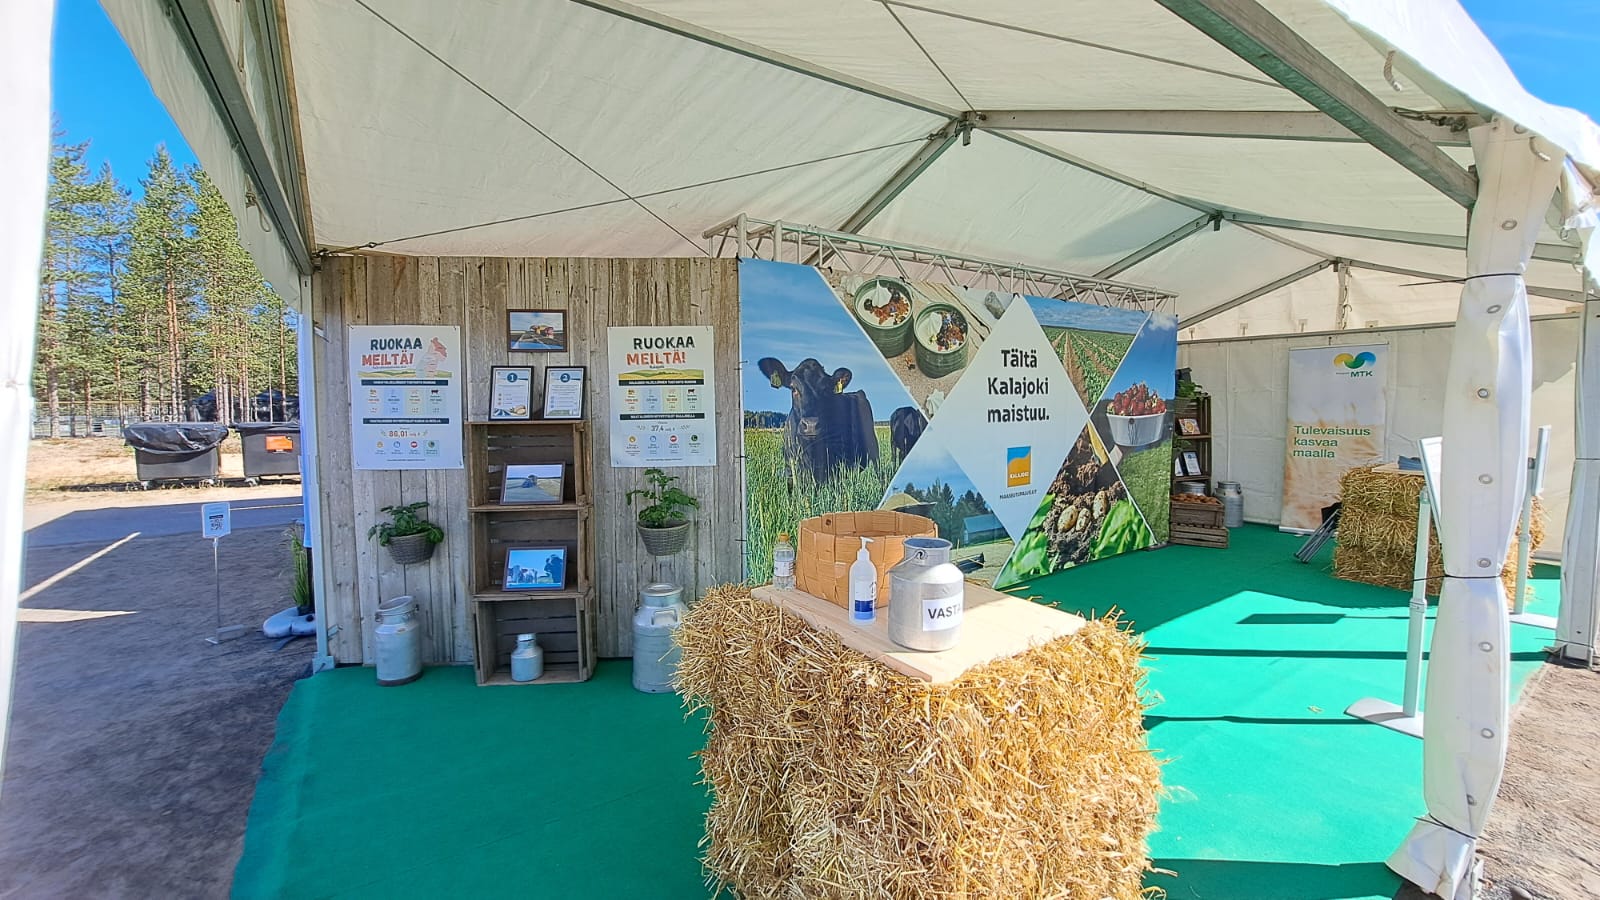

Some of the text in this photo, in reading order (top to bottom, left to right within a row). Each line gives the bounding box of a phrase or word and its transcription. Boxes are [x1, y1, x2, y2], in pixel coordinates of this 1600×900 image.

[370, 337, 423, 351] RUOKAA
[633, 336, 695, 350] RUOKAA
[362, 350, 414, 366] MEILTÄ!
[626, 350, 686, 366] MEILTÄ!
[1001, 348, 1038, 368] Tältä
[1350, 370, 1373, 378] MTK
[987, 376, 1049, 399] Kalajoki
[987, 404, 1050, 423] maistuu.
[1293, 425, 1371, 436] Tulevaisuus
[1293, 436, 1338, 447] kasvaa
[1293, 449, 1335, 458] maalla
